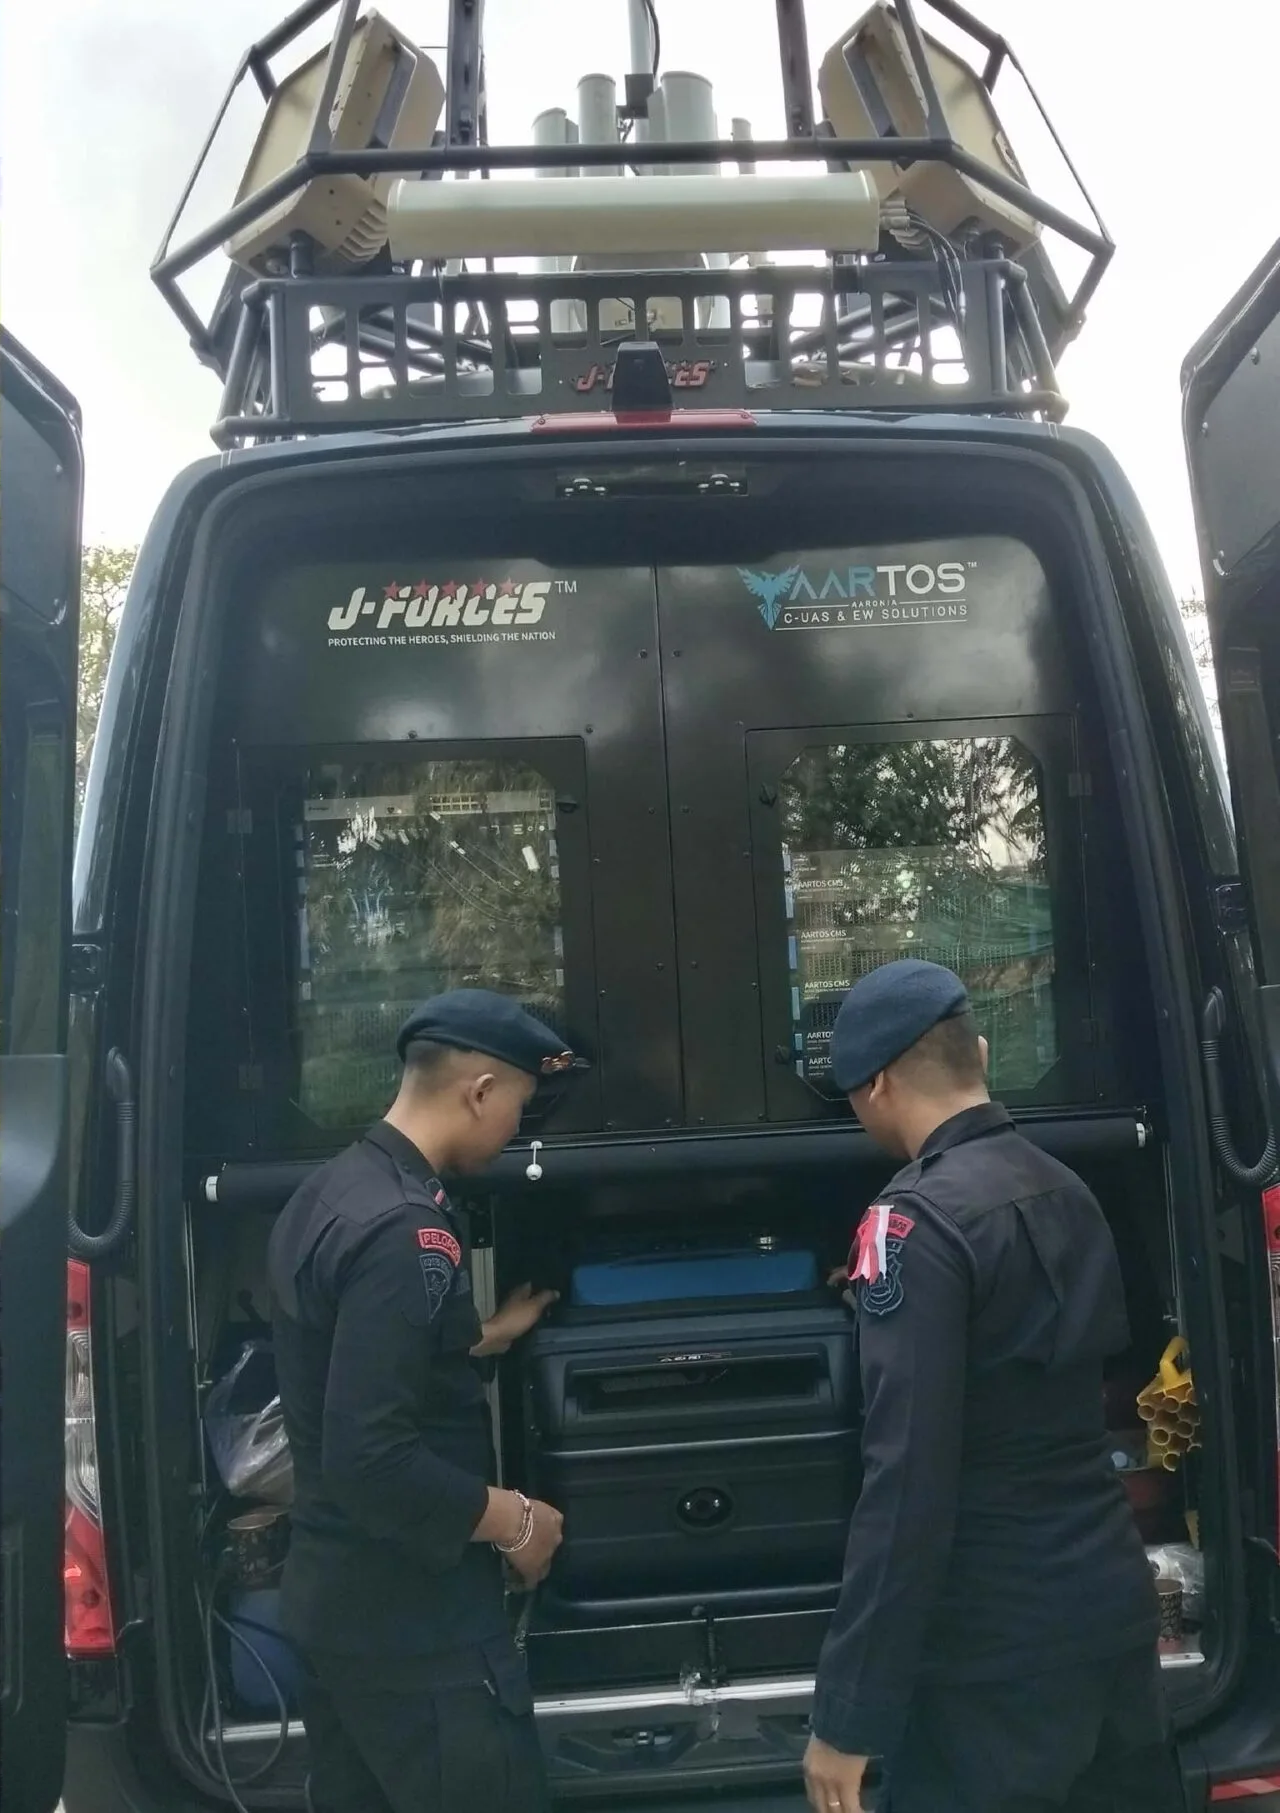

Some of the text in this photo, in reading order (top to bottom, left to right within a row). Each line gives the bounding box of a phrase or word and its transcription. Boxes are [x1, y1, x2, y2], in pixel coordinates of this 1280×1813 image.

[554, 580, 578, 593] TM
[789, 563, 966, 601] AARTOS
[851, 599, 898, 608] AARONIA
[784, 605, 968, 624] C-UAS & EW SOLUTIONS
[328, 631, 556, 647] PROTECTING THE HEROES, SHIELDING THE NATION
[801, 930, 830, 940] AARTOS
[830, 929, 847, 938] CMS
[804, 979, 850, 989] AARTOS CMS
[807, 1031, 834, 1040] AARTO
